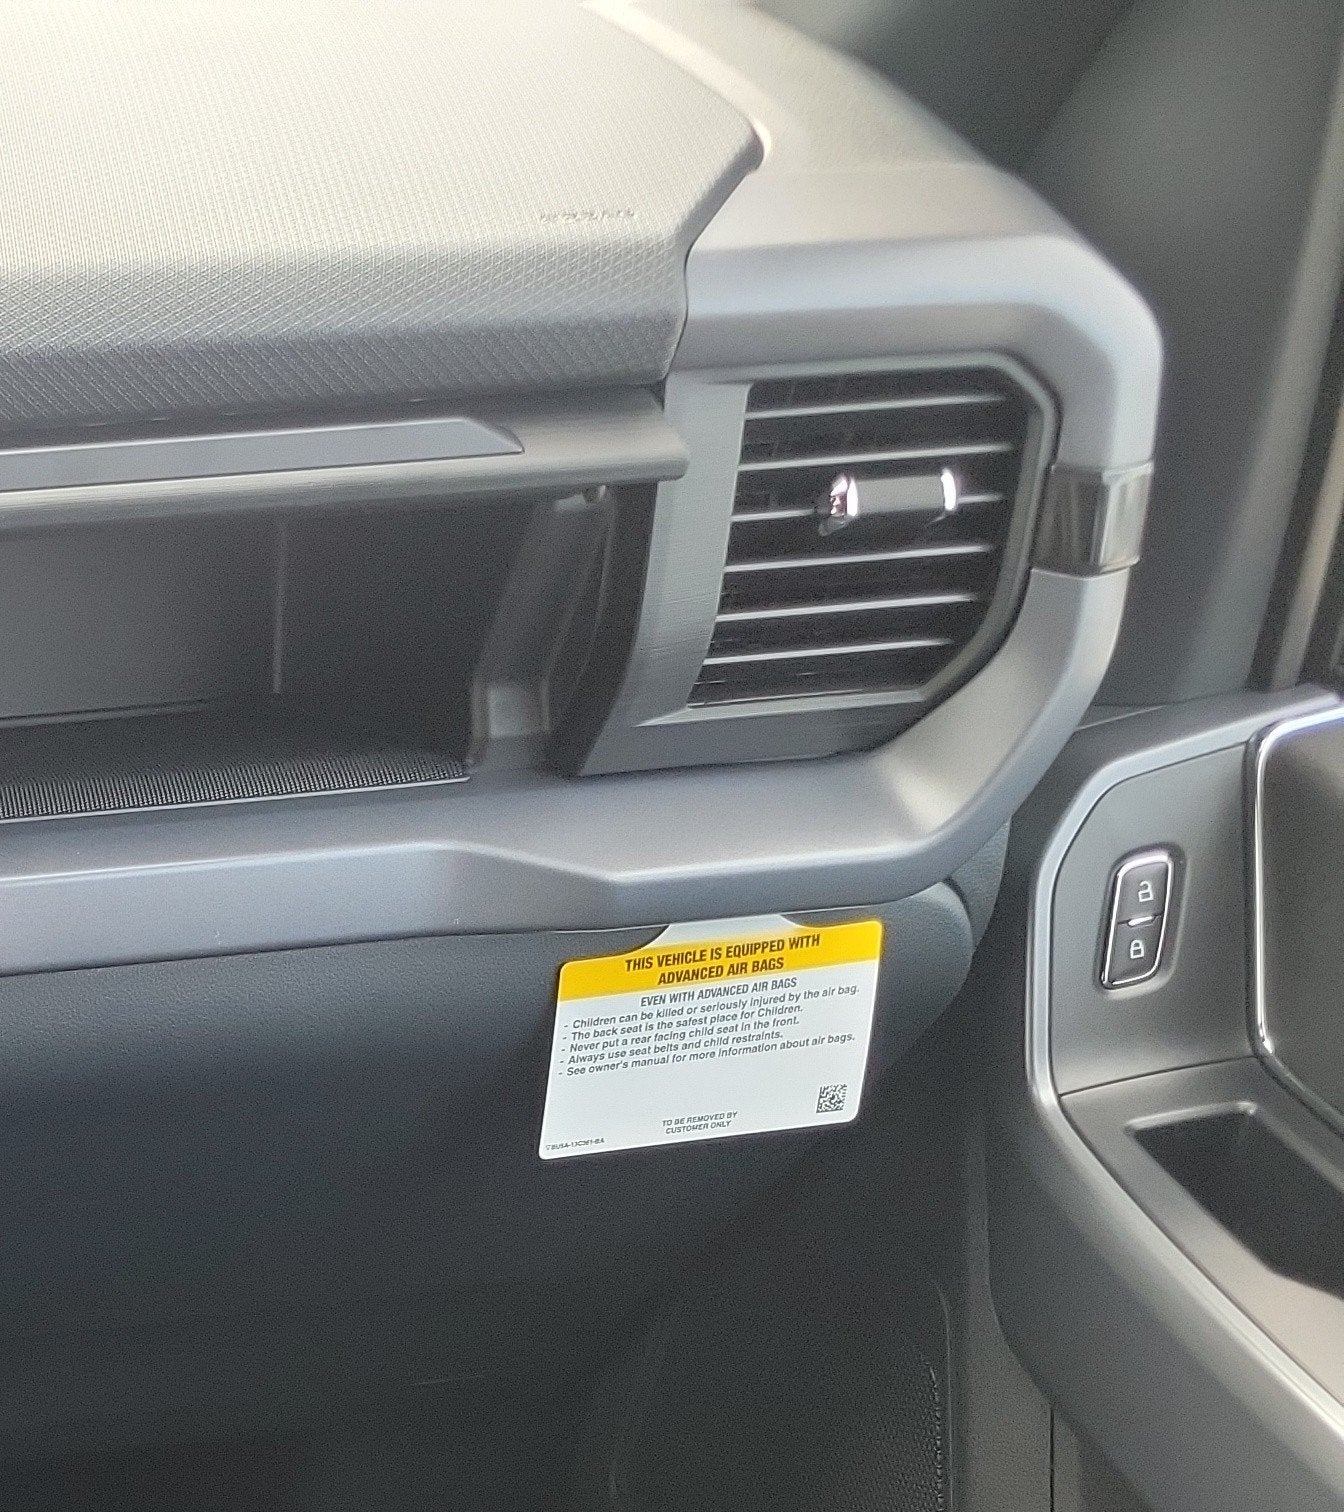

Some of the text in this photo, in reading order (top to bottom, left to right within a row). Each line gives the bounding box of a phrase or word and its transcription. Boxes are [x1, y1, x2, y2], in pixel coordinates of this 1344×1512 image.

[625, 934, 820, 972] THIS VEHICLE IS EQUIPPED WITH
[657, 957, 784, 986] ADVANCED AIR BAGS
[572, 984, 860, 1029] Children can be killed or seriously injured by the air bag.
[640, 976, 798, 1007] EVEN WITH ADVANCED AIR BAGS
[569, 1016, 800, 1053] Never put a rear facing child seat in the front.
[571, 1004, 804, 1041] The back seat is the safest place for Children.
[566, 1032, 855, 1076] See owner's manual for more information about air bags.
[568, 1030, 783, 1065] Always use seat belts and child restraints.
[662, 1111, 738, 1127] TO BE REMOVED BY
[665, 1120, 732, 1134] CUSTOMER ONLY
